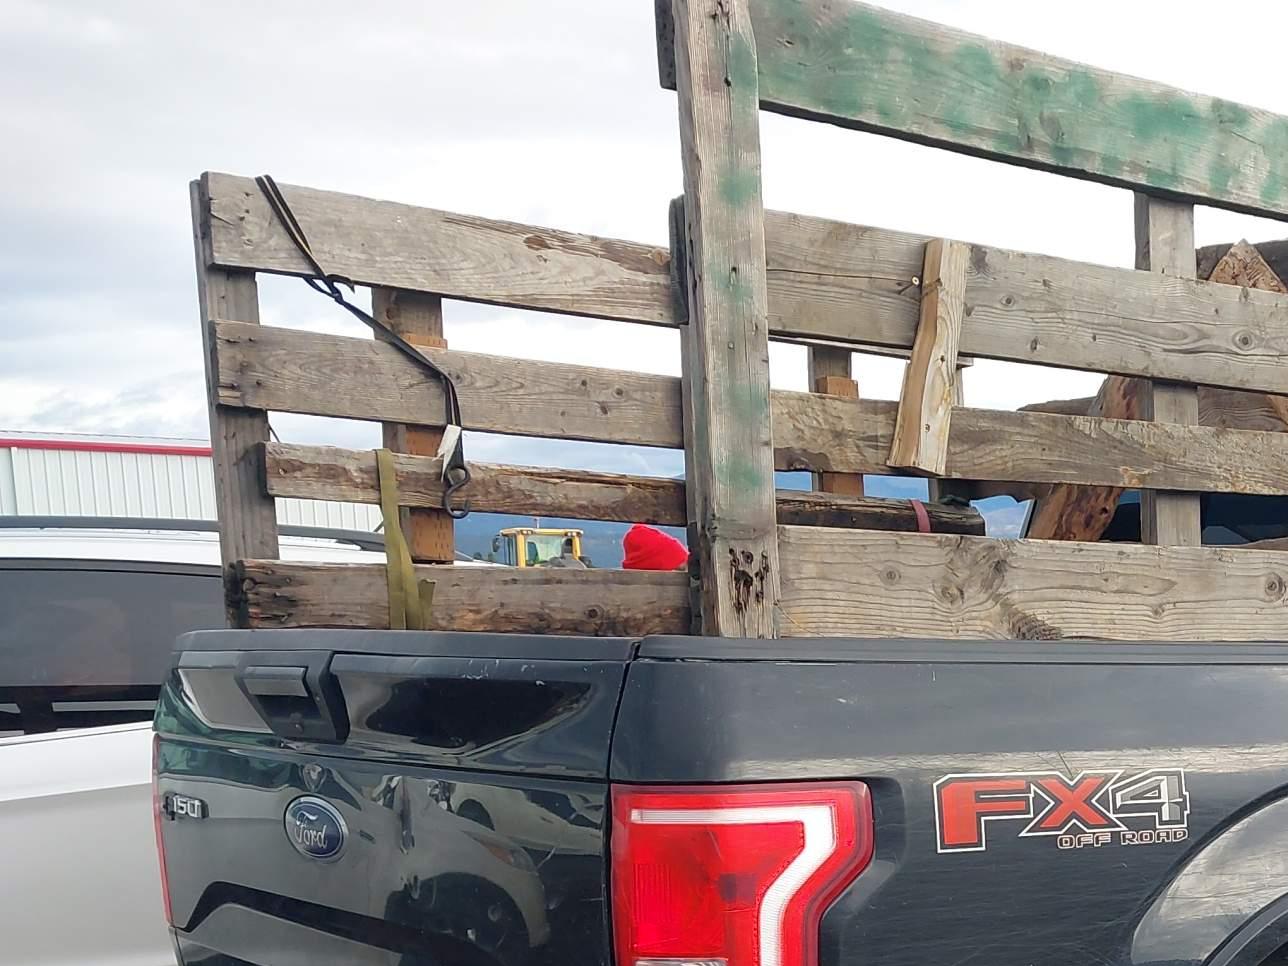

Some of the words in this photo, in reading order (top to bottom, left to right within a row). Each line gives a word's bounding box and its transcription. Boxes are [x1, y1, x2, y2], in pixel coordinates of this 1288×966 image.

[295, 810, 328, 849] Ford
[933, 768, 1190, 853] FX4
[1057, 832, 1112, 849] OFF
[1120, 829, 1188, 846] ROAD
